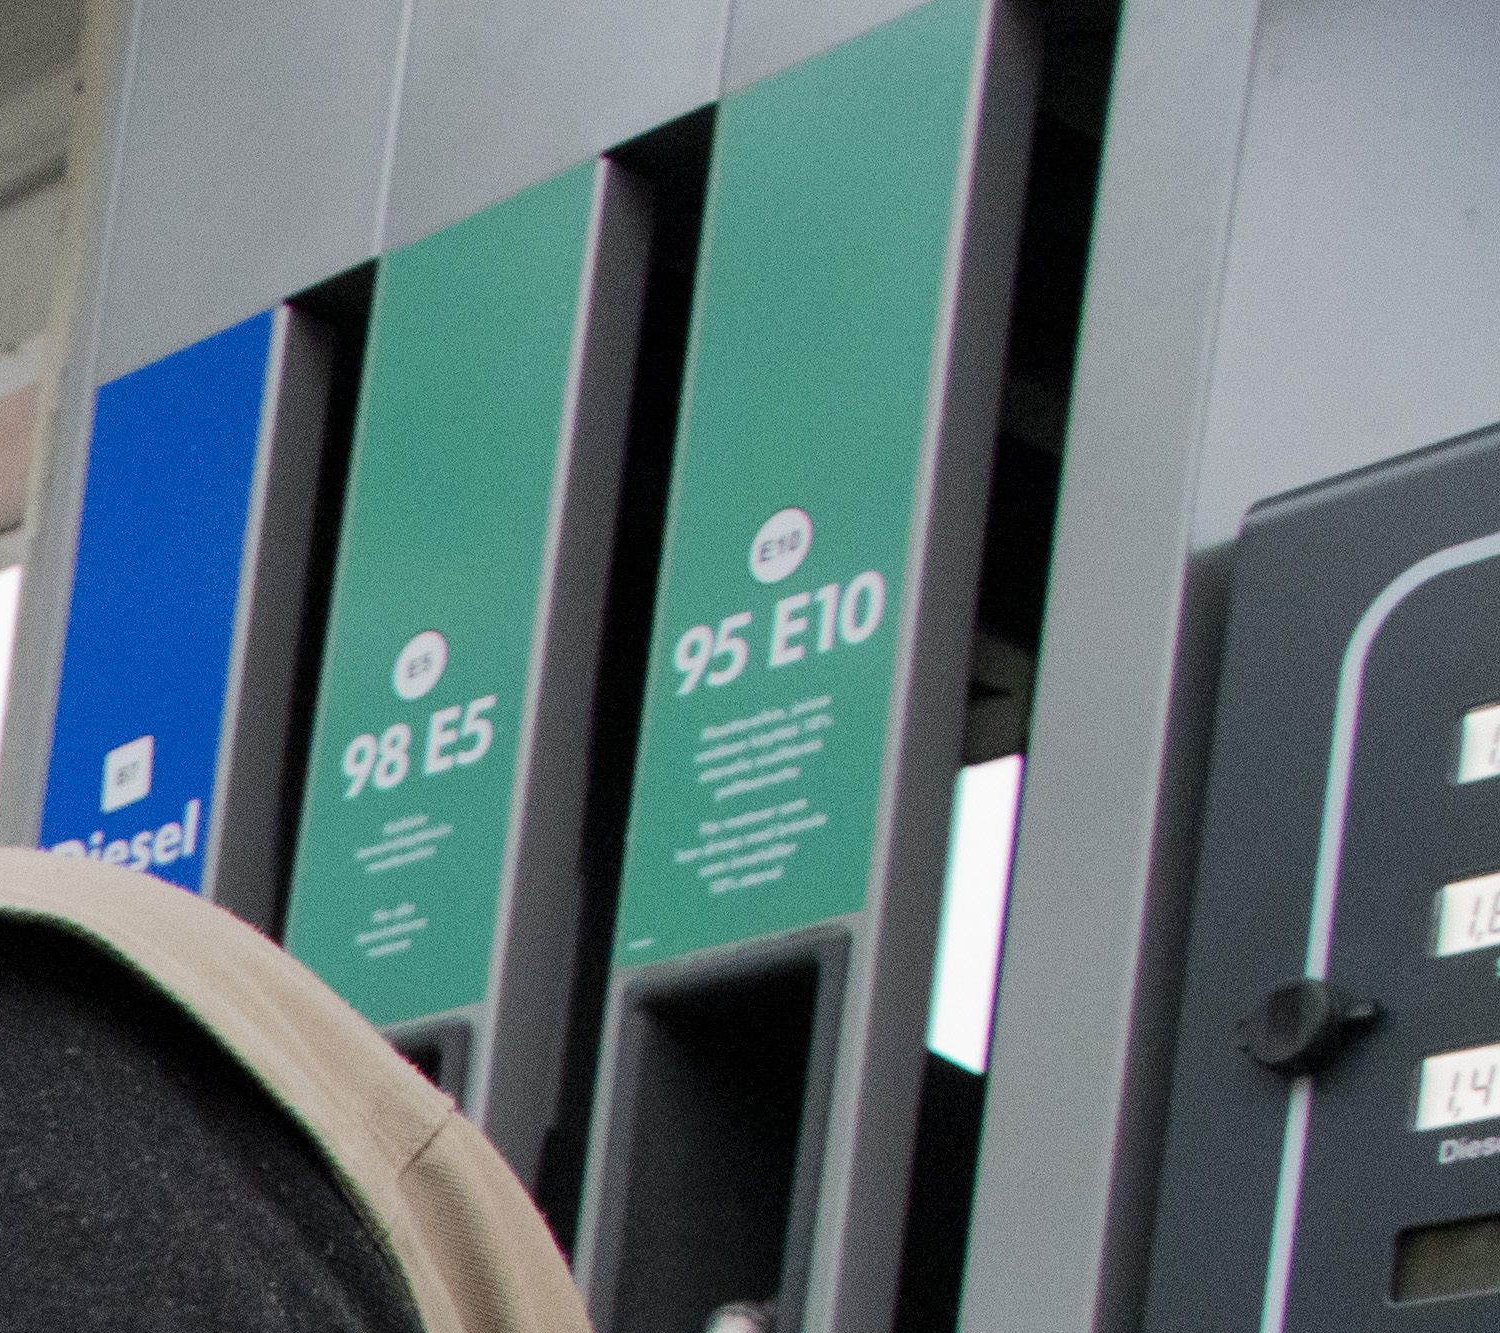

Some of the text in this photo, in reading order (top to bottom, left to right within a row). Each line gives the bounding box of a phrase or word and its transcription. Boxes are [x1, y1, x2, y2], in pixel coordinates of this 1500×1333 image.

[674, 569, 886, 696] 95 E10
[342, 693, 498, 799] 98 E5
